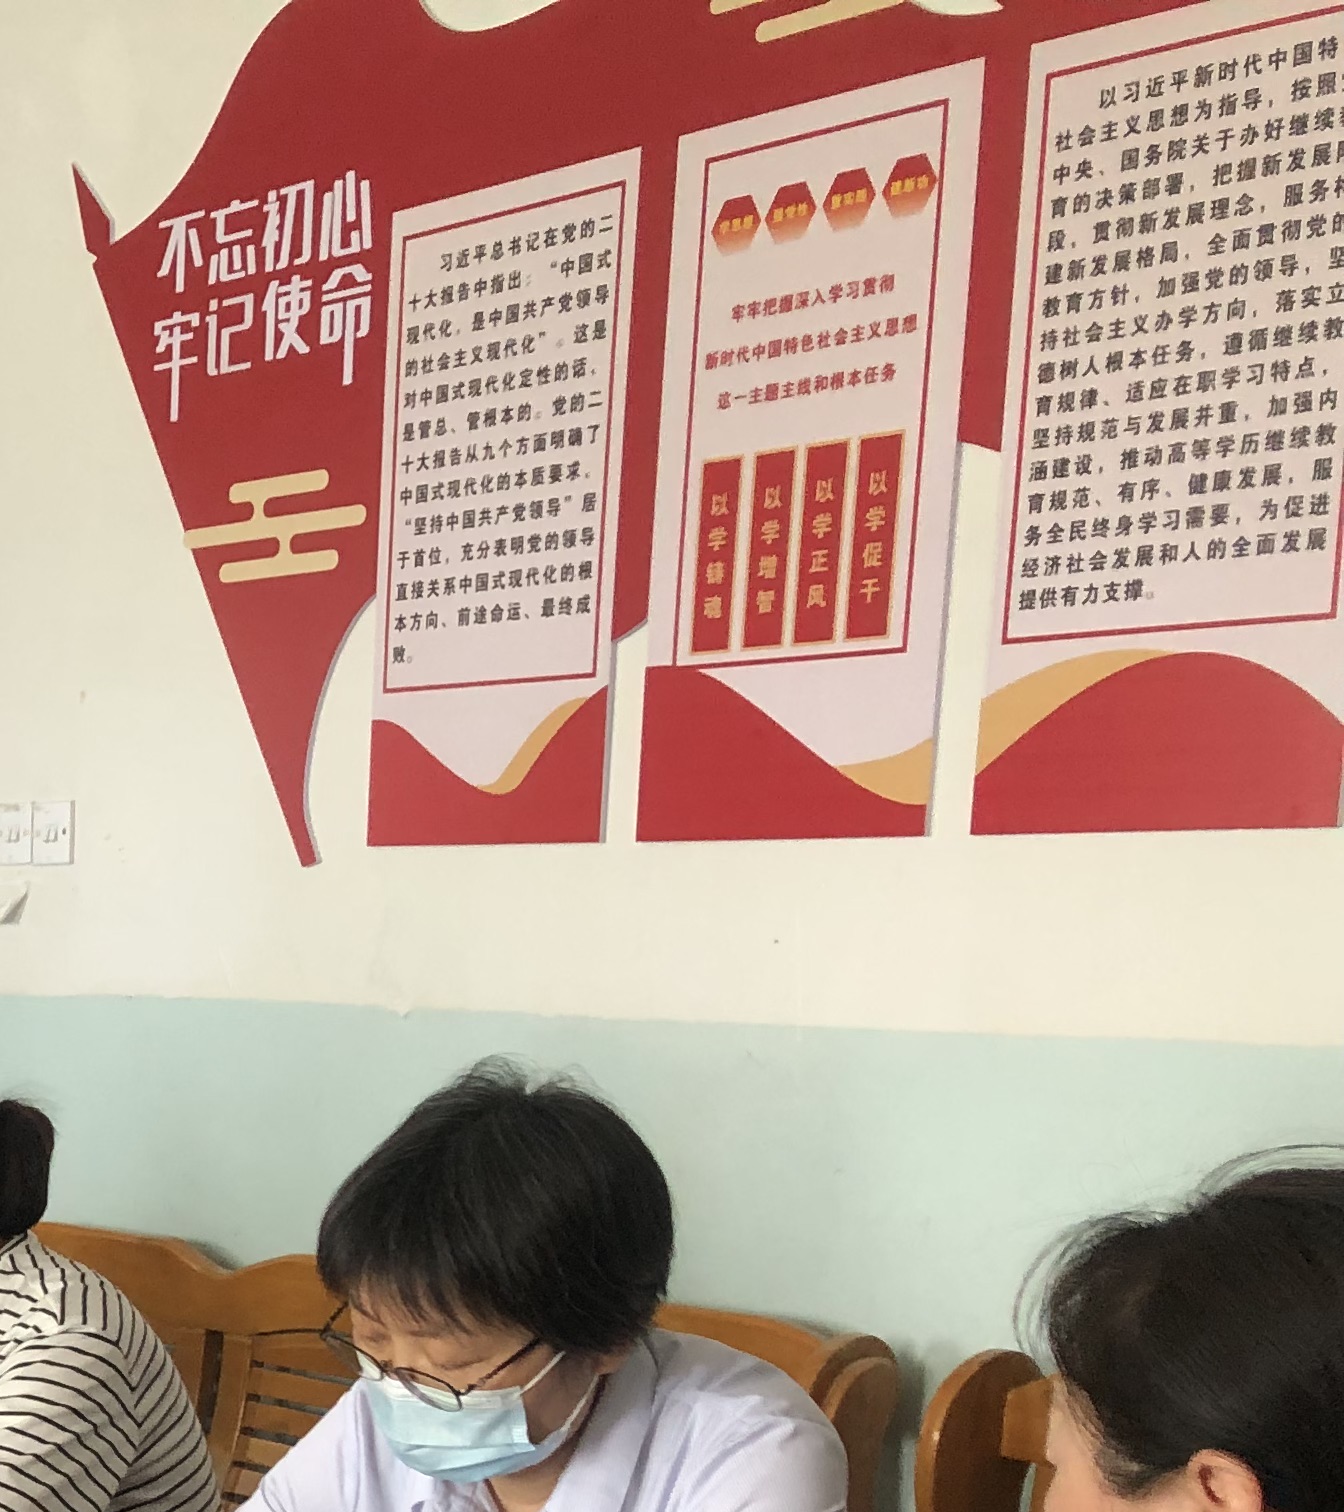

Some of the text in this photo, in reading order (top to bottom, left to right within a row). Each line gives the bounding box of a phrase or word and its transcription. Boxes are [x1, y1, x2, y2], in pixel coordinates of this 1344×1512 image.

[1098, 35, 1339, 109] 以习近平新时代中国特
[1054, 71, 1344, 153] 社会主义思想为指导，按照
[156, 169, 372, 293] 不忘初心
[440, 214, 613, 272] 习近平总书记在党的二
[730, 273, 895, 324] 牢牢把握深入学习贯彻
[153, 263, 373, 423] 牢记使命
[704, 313, 918, 371] 新时代中国特色社会主义思想
[717, 362, 897, 410] 这一主题主线和根本任务
[401, 423, 601, 474] 十大报告从九个方面明确了
[806, 477, 834, 609] 以学正风
[859, 469, 888, 604] 以学促干
[1020, 527, 1328, 579] 经济社会发展和人的全面发展
[395, 560, 593, 602] 直接关系中国式现代化的根
